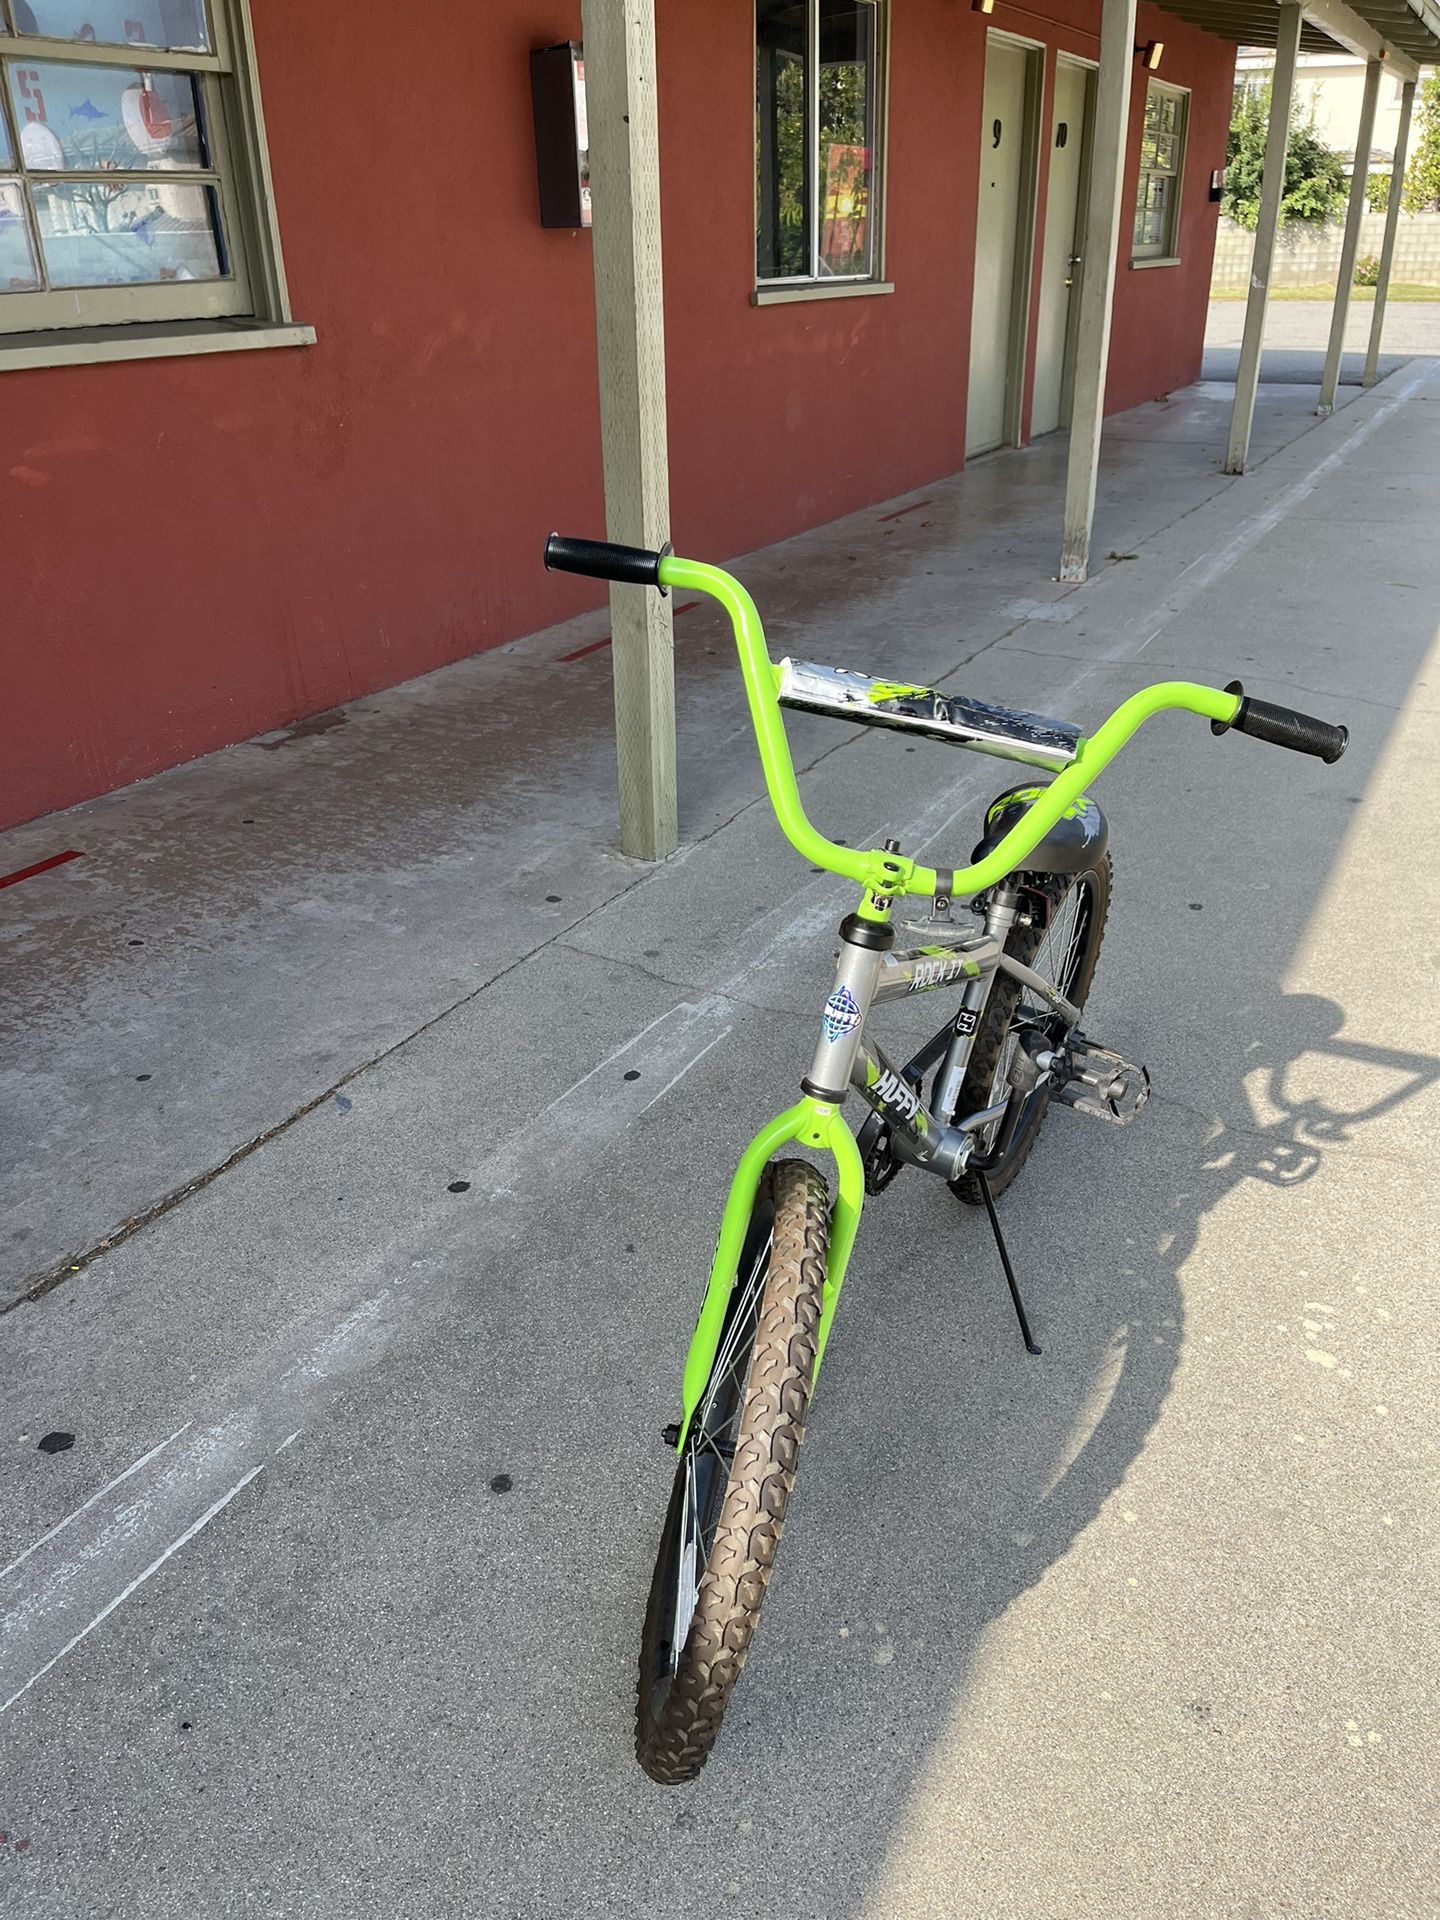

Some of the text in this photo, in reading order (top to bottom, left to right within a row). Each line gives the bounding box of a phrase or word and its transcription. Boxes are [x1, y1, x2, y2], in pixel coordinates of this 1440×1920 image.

[992, 119, 1002, 149] 9
[1055, 122, 1068, 149] 10
[908, 958, 964, 992] ROCK IT
[870, 1067, 920, 1120] HUFFY
